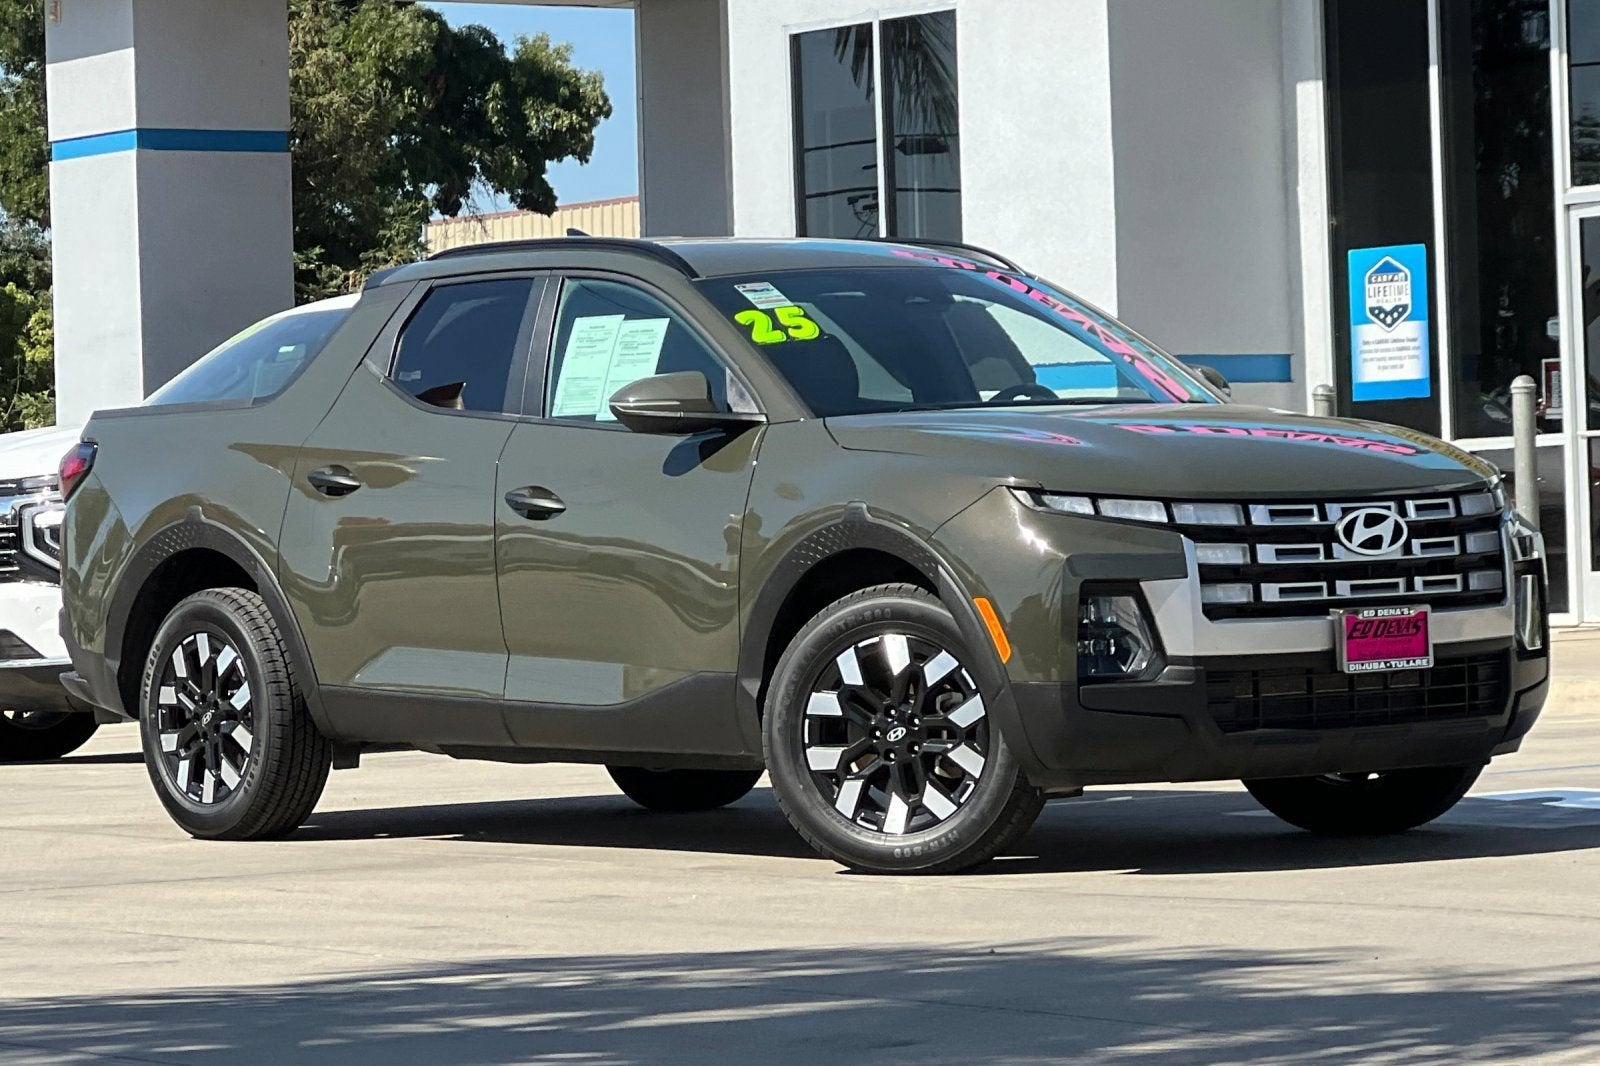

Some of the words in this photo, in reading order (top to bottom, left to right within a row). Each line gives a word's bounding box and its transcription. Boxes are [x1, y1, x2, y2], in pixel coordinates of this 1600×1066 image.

[1367, 284, 1409, 299] LIFETIME
[734, 306, 820, 344] 25
[1363, 609, 1375, 617] ED
